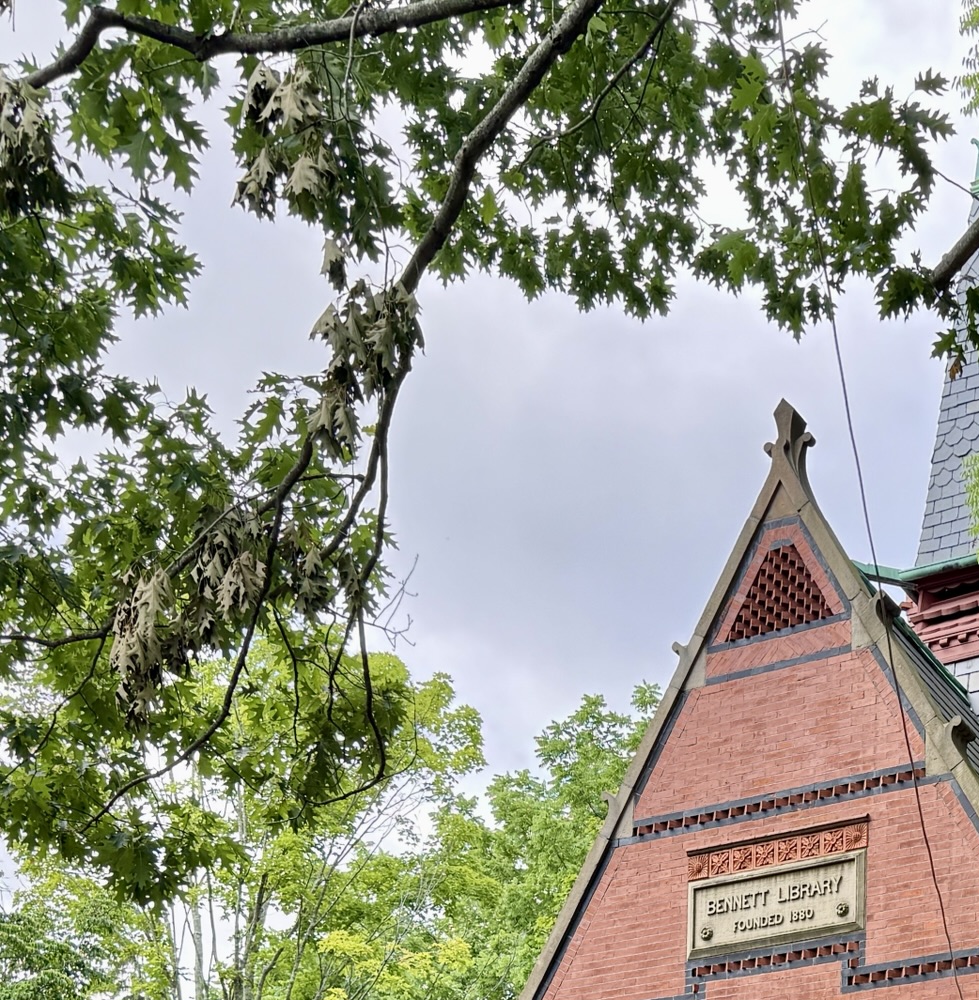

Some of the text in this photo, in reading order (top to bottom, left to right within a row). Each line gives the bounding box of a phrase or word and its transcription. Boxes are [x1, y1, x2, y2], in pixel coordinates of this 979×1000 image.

[706, 876, 842, 916] BENNETT LIBRARY
[733, 908, 814, 933] FOUNDED 1880
